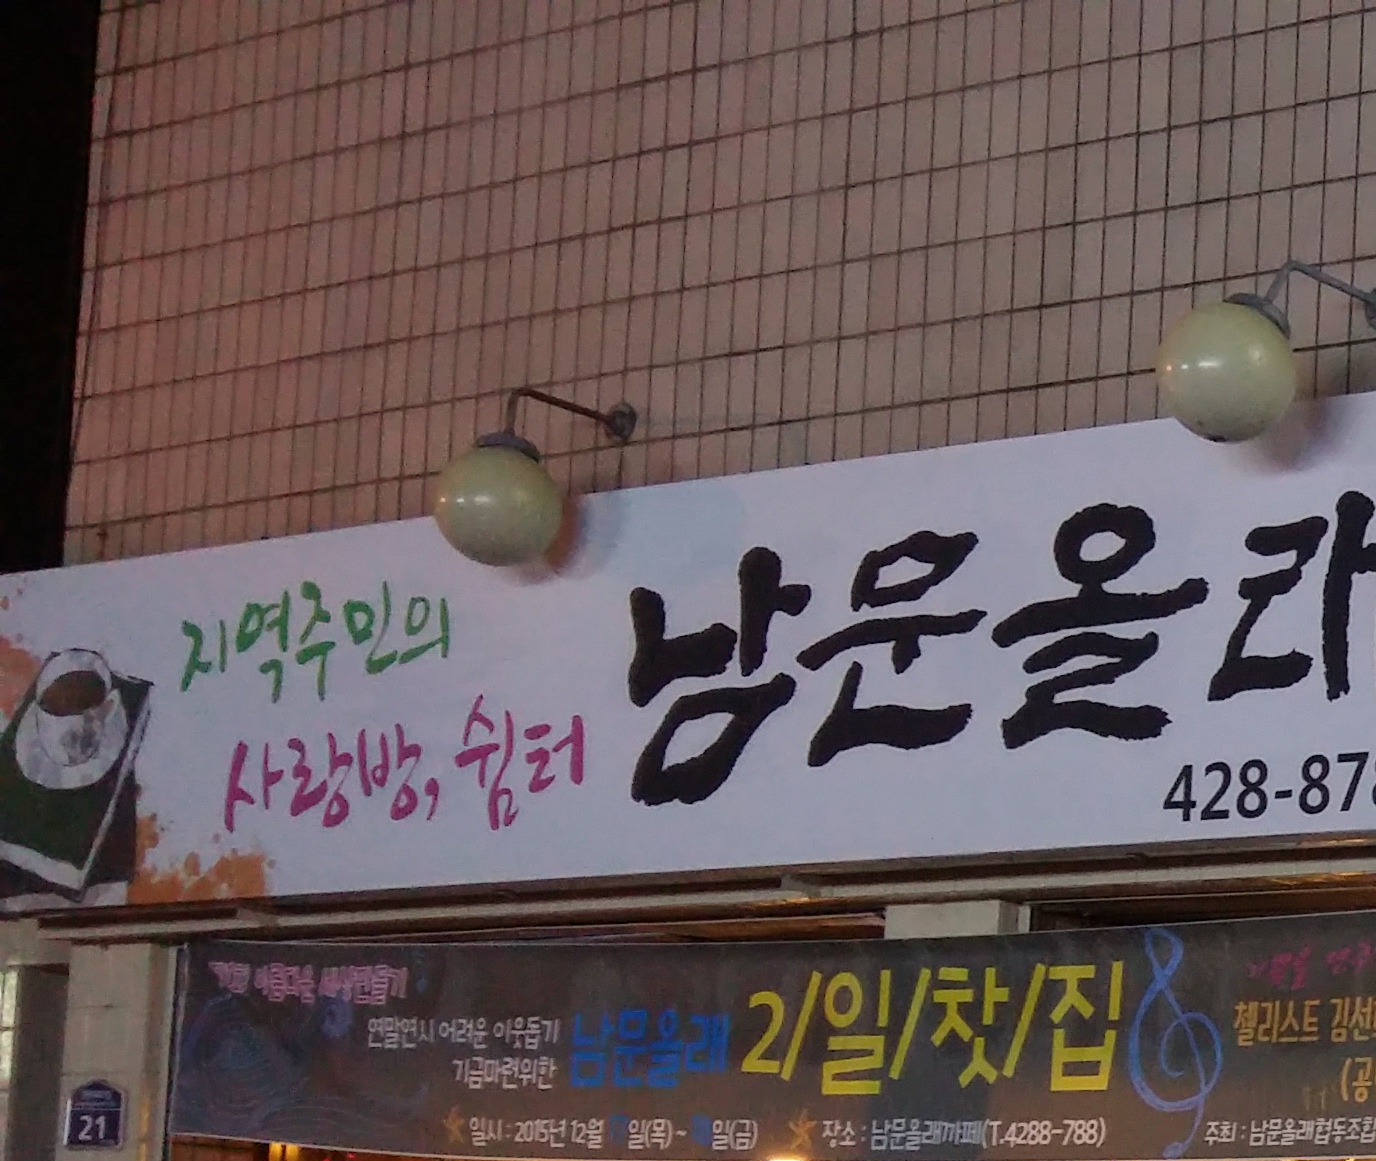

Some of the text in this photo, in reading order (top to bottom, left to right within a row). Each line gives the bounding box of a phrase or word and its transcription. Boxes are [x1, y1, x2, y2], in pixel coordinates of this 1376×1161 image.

[179, 578, 451, 701] 지역주민의
[222, 692, 587, 832] 사랑방, 쉼터
[366, 1015, 561, 1051] 연말연시 어려운 이웃돕기
[1232, 999, 1321, 1048] 첼리스트
[569, 1008, 731, 1089] 남문올래
[451, 1055, 559, 1091] 기금마련위한
[78, 1114, 106, 1141] 21
[691, 1114, 759, 1152] 일(금)
